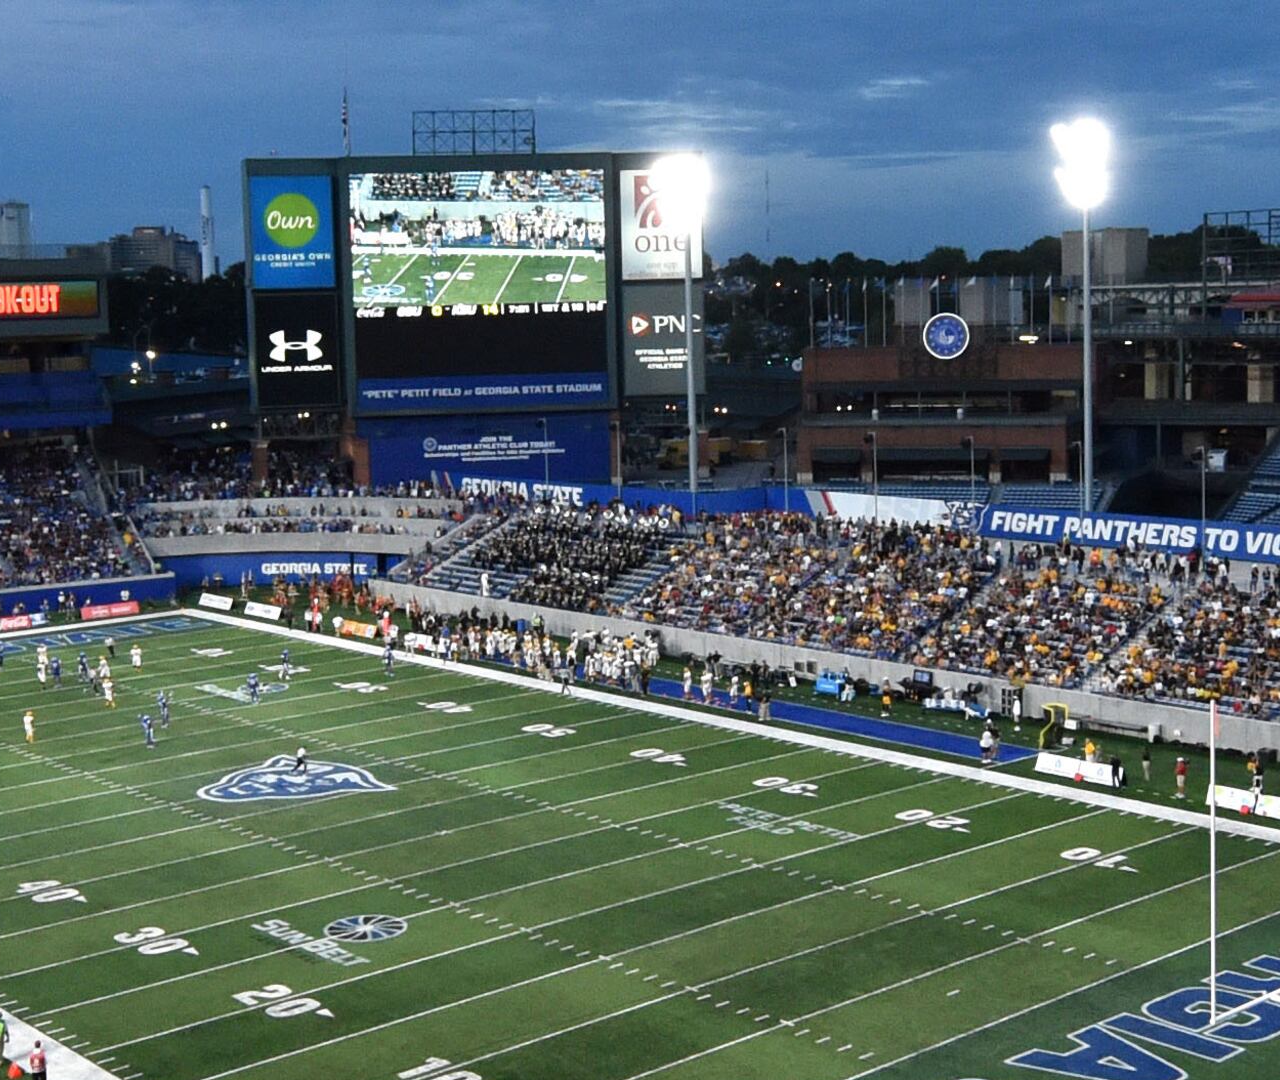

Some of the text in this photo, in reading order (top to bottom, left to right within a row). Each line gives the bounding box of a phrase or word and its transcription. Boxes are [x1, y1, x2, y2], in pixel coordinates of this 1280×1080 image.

[267, 210, 316, 229] Own
[635, 234, 687, 253] one
[254, 253, 332, 262] GEORGIA'S OWN
[294, 364, 333, 372] ARMOUR
[401, 389, 430, 398] PETIT
[432, 388, 461, 397] FIELD
[475, 386, 520, 396] GEORGIA
[522, 385, 554, 394] STATE
[556, 384, 602, 393] STADIUM
[461, 477, 584, 506] GEORGIA STATE
[990, 511, 1060, 536] FIGHT
[1064, 516, 1197, 549] PANTHERS
[1205, 527, 1239, 551] TO
[261, 563, 368, 575] GEORGIA STATE
[521, 723, 577, 738] 50
[629, 748, 686, 764] 40
[752, 776, 818, 796] 30
[894, 808, 969, 829] 20
[1060, 846, 1131, 869] 10
[16, 879, 81, 903] 40
[113, 926, 188, 956] 30
[251, 919, 371, 967] SUN BELT
[232, 984, 321, 1018] 20
